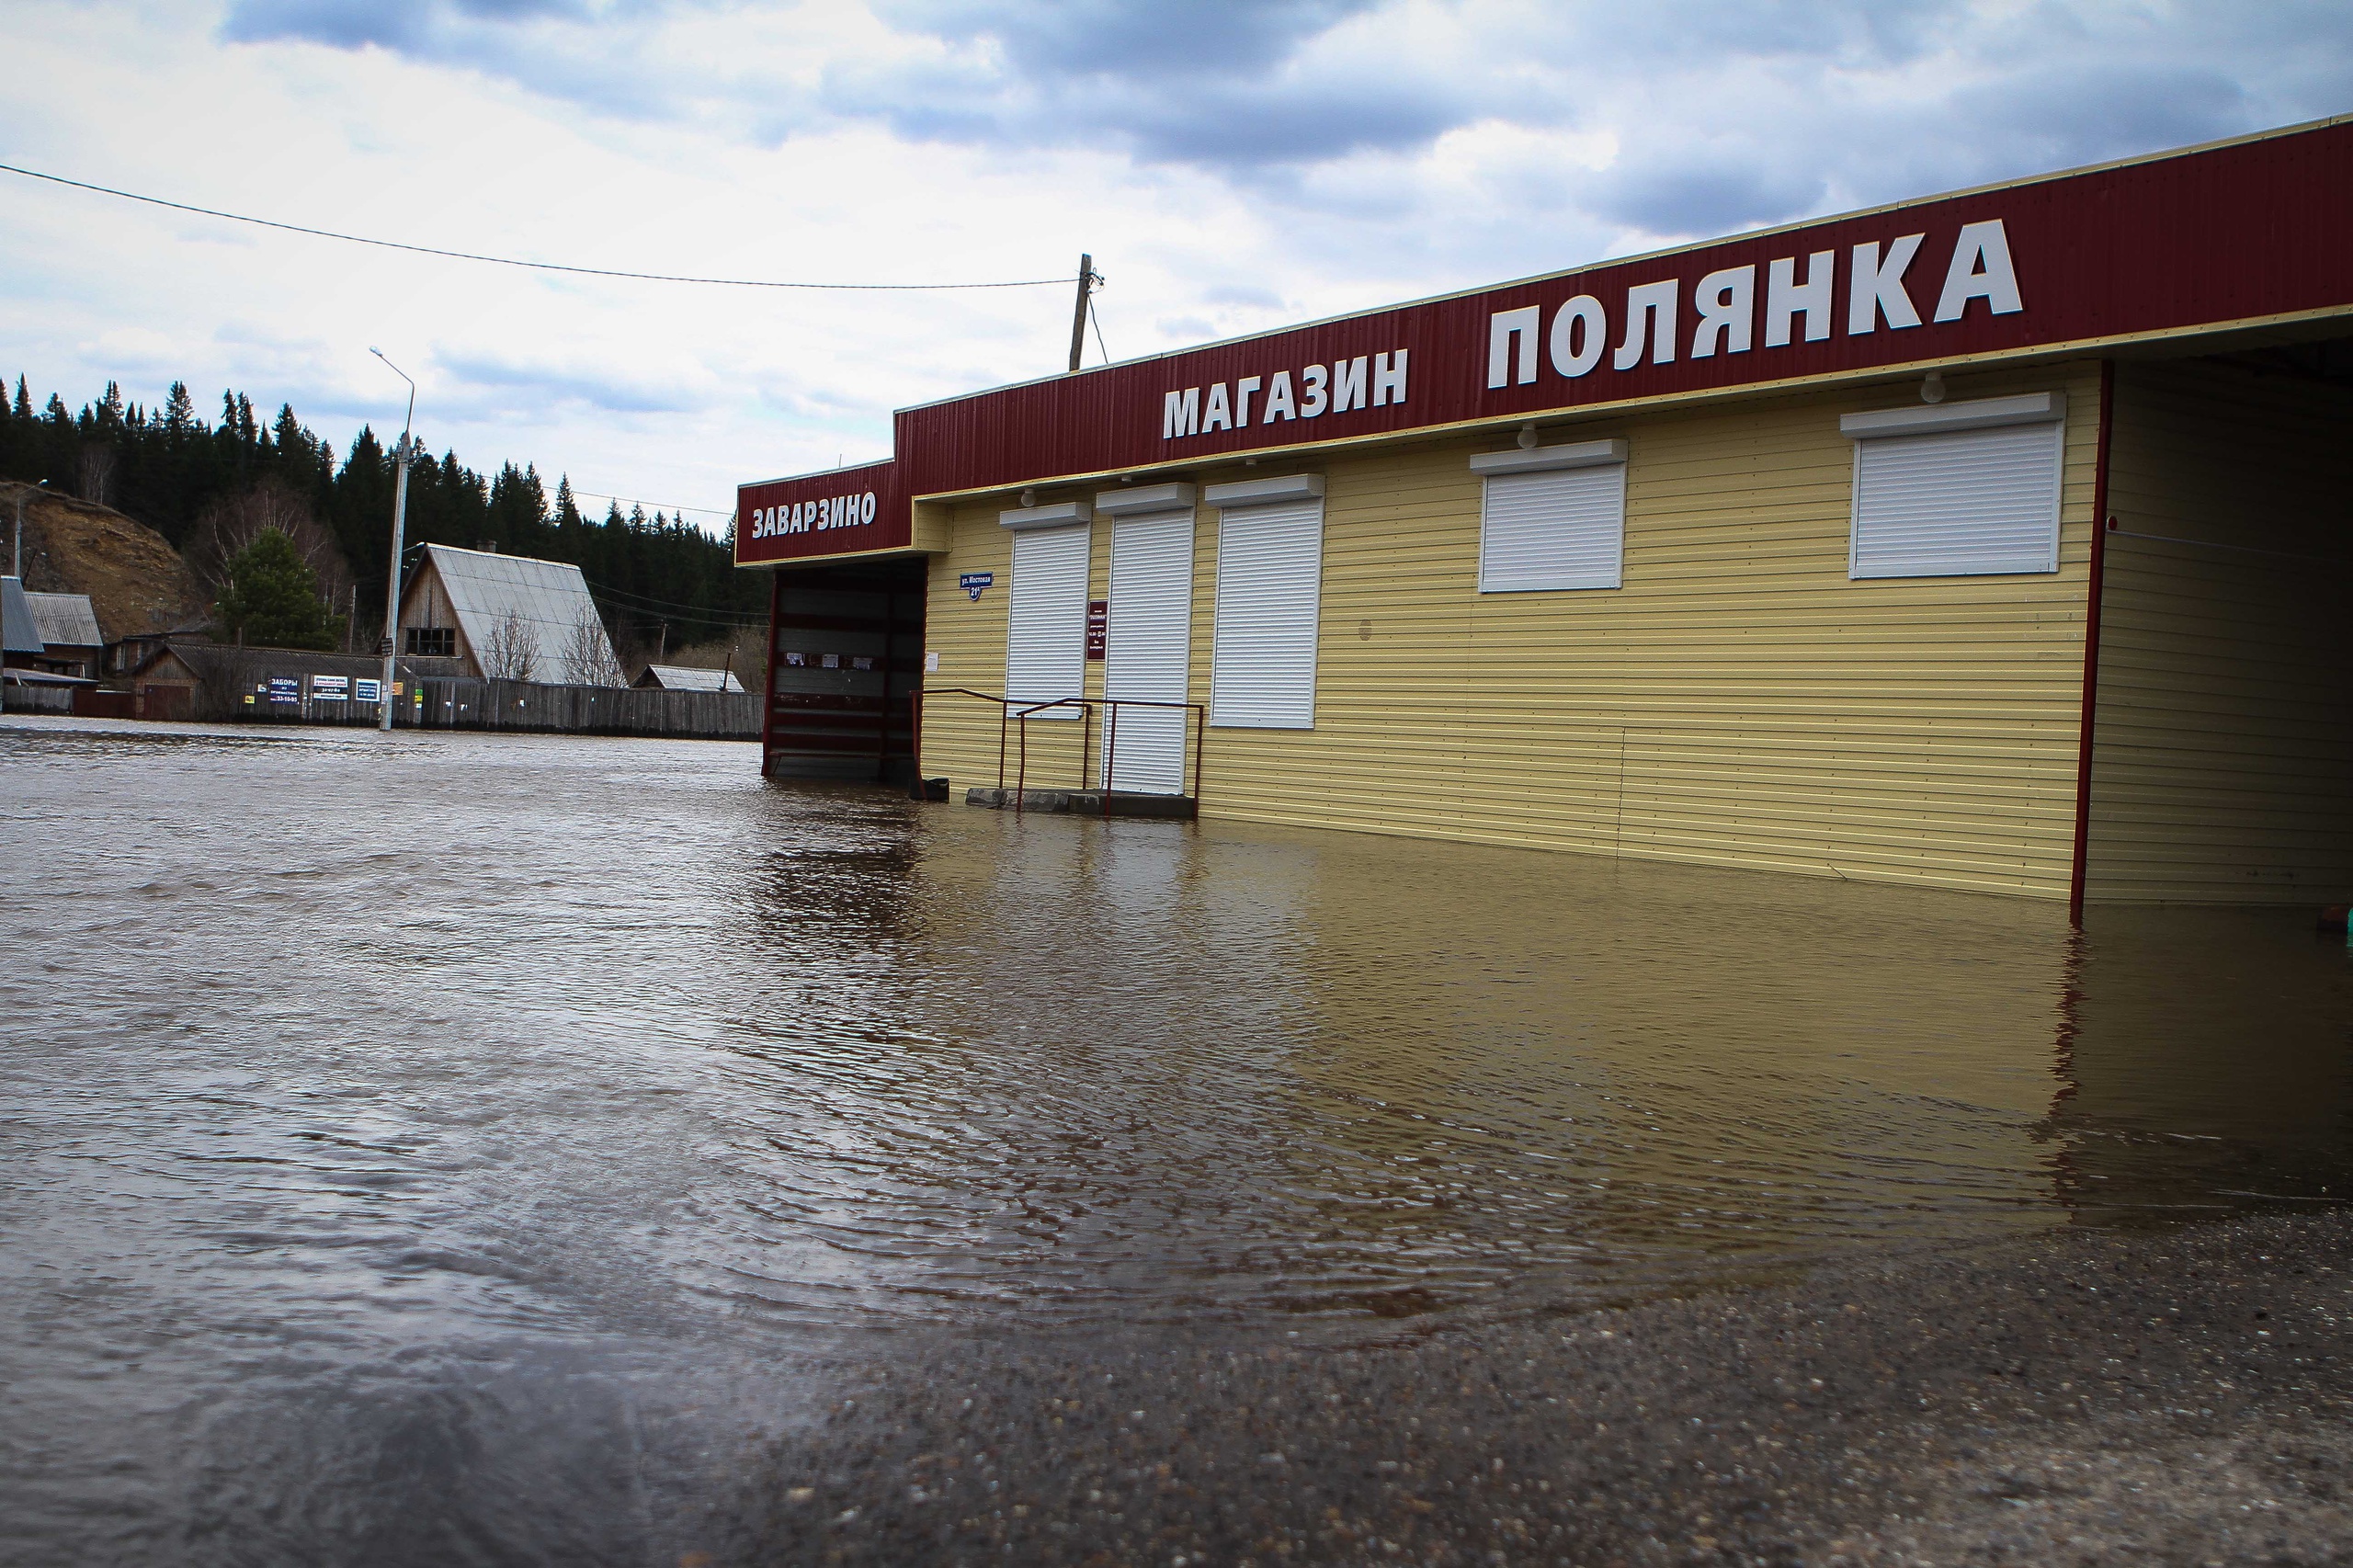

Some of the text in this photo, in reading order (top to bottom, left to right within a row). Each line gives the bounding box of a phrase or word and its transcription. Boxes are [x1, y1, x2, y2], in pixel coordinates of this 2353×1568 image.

[1163, 219, 2023, 439] МАГАЗИН ПОЛЯНКА
[752, 491, 876, 539] ЗАВАРЗИНО
[969, 575, 991, 584] Мостовая
[271, 678, 298, 687] ЗАБОРЫ
